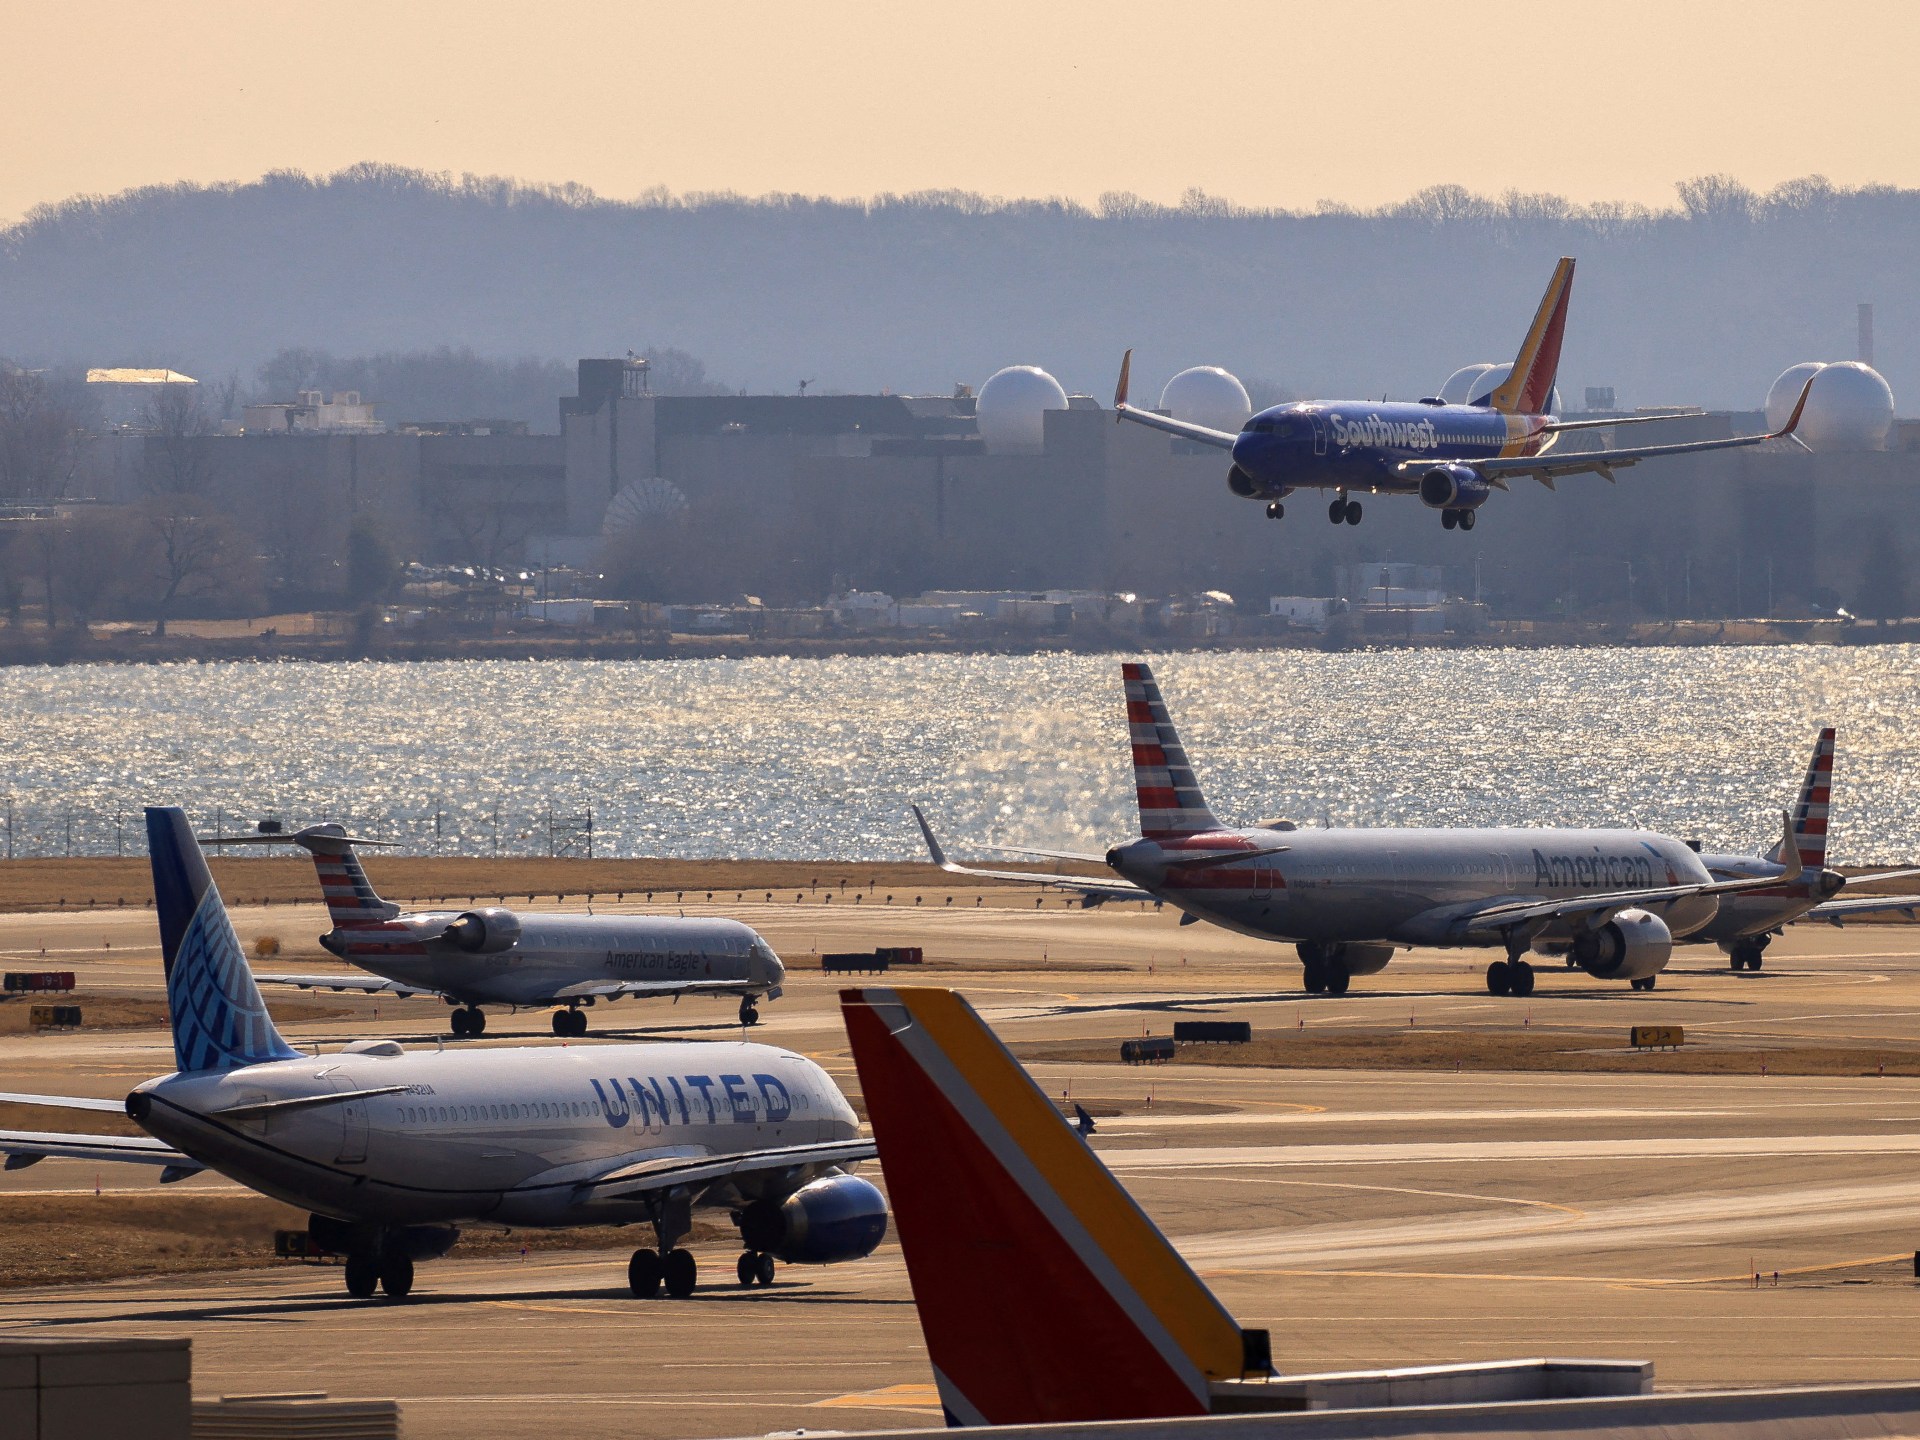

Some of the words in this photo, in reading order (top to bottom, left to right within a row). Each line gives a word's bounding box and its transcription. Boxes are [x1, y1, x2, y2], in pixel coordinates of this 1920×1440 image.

[1330, 413, 1438, 449] Southwest
[1532, 846, 1653, 888] American
[605, 950, 664, 969] American
[667, 951, 699, 975] Eagle
[16, 976, 23, 987] E
[41, 975, 63, 988] 19-1
[590, 1074, 792, 1128] UNITED
[287, 1234, 297, 1251] C
